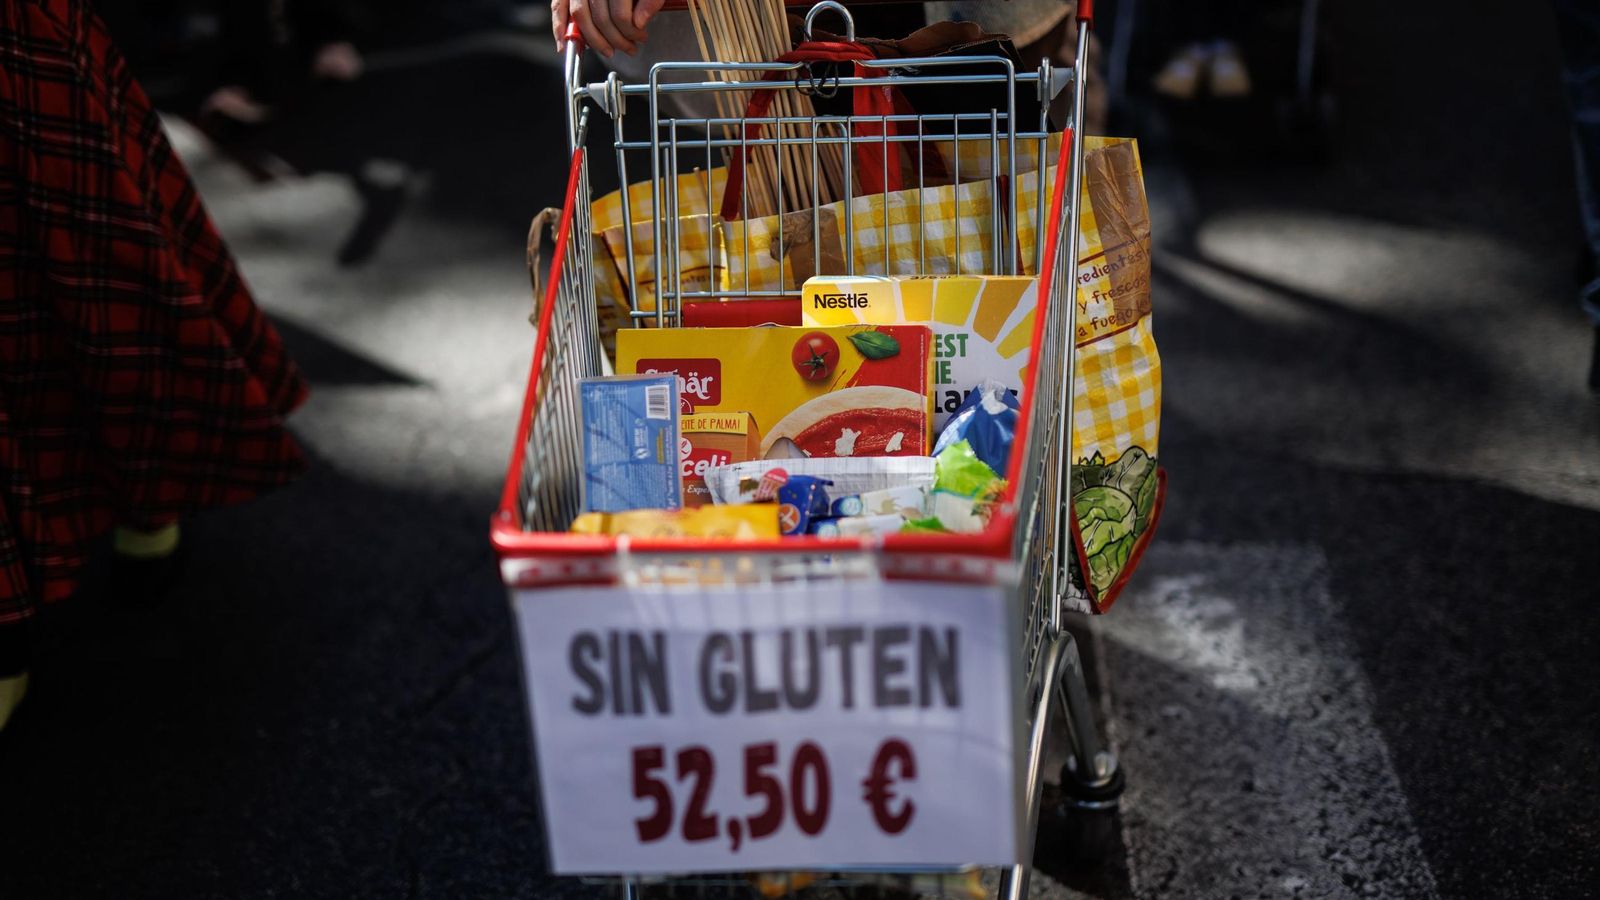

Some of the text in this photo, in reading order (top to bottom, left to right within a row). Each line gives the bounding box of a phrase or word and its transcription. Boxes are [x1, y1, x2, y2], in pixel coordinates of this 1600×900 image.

[814, 292, 868, 309] Nestlé
[1078, 276, 1147, 314] y frescos
[1078, 308, 1133, 337] a fuego
[698, 418, 706, 430] DE
[569, 625, 962, 716] SIN GLUTEN
[631, 738, 918, 852] 52,50 €
